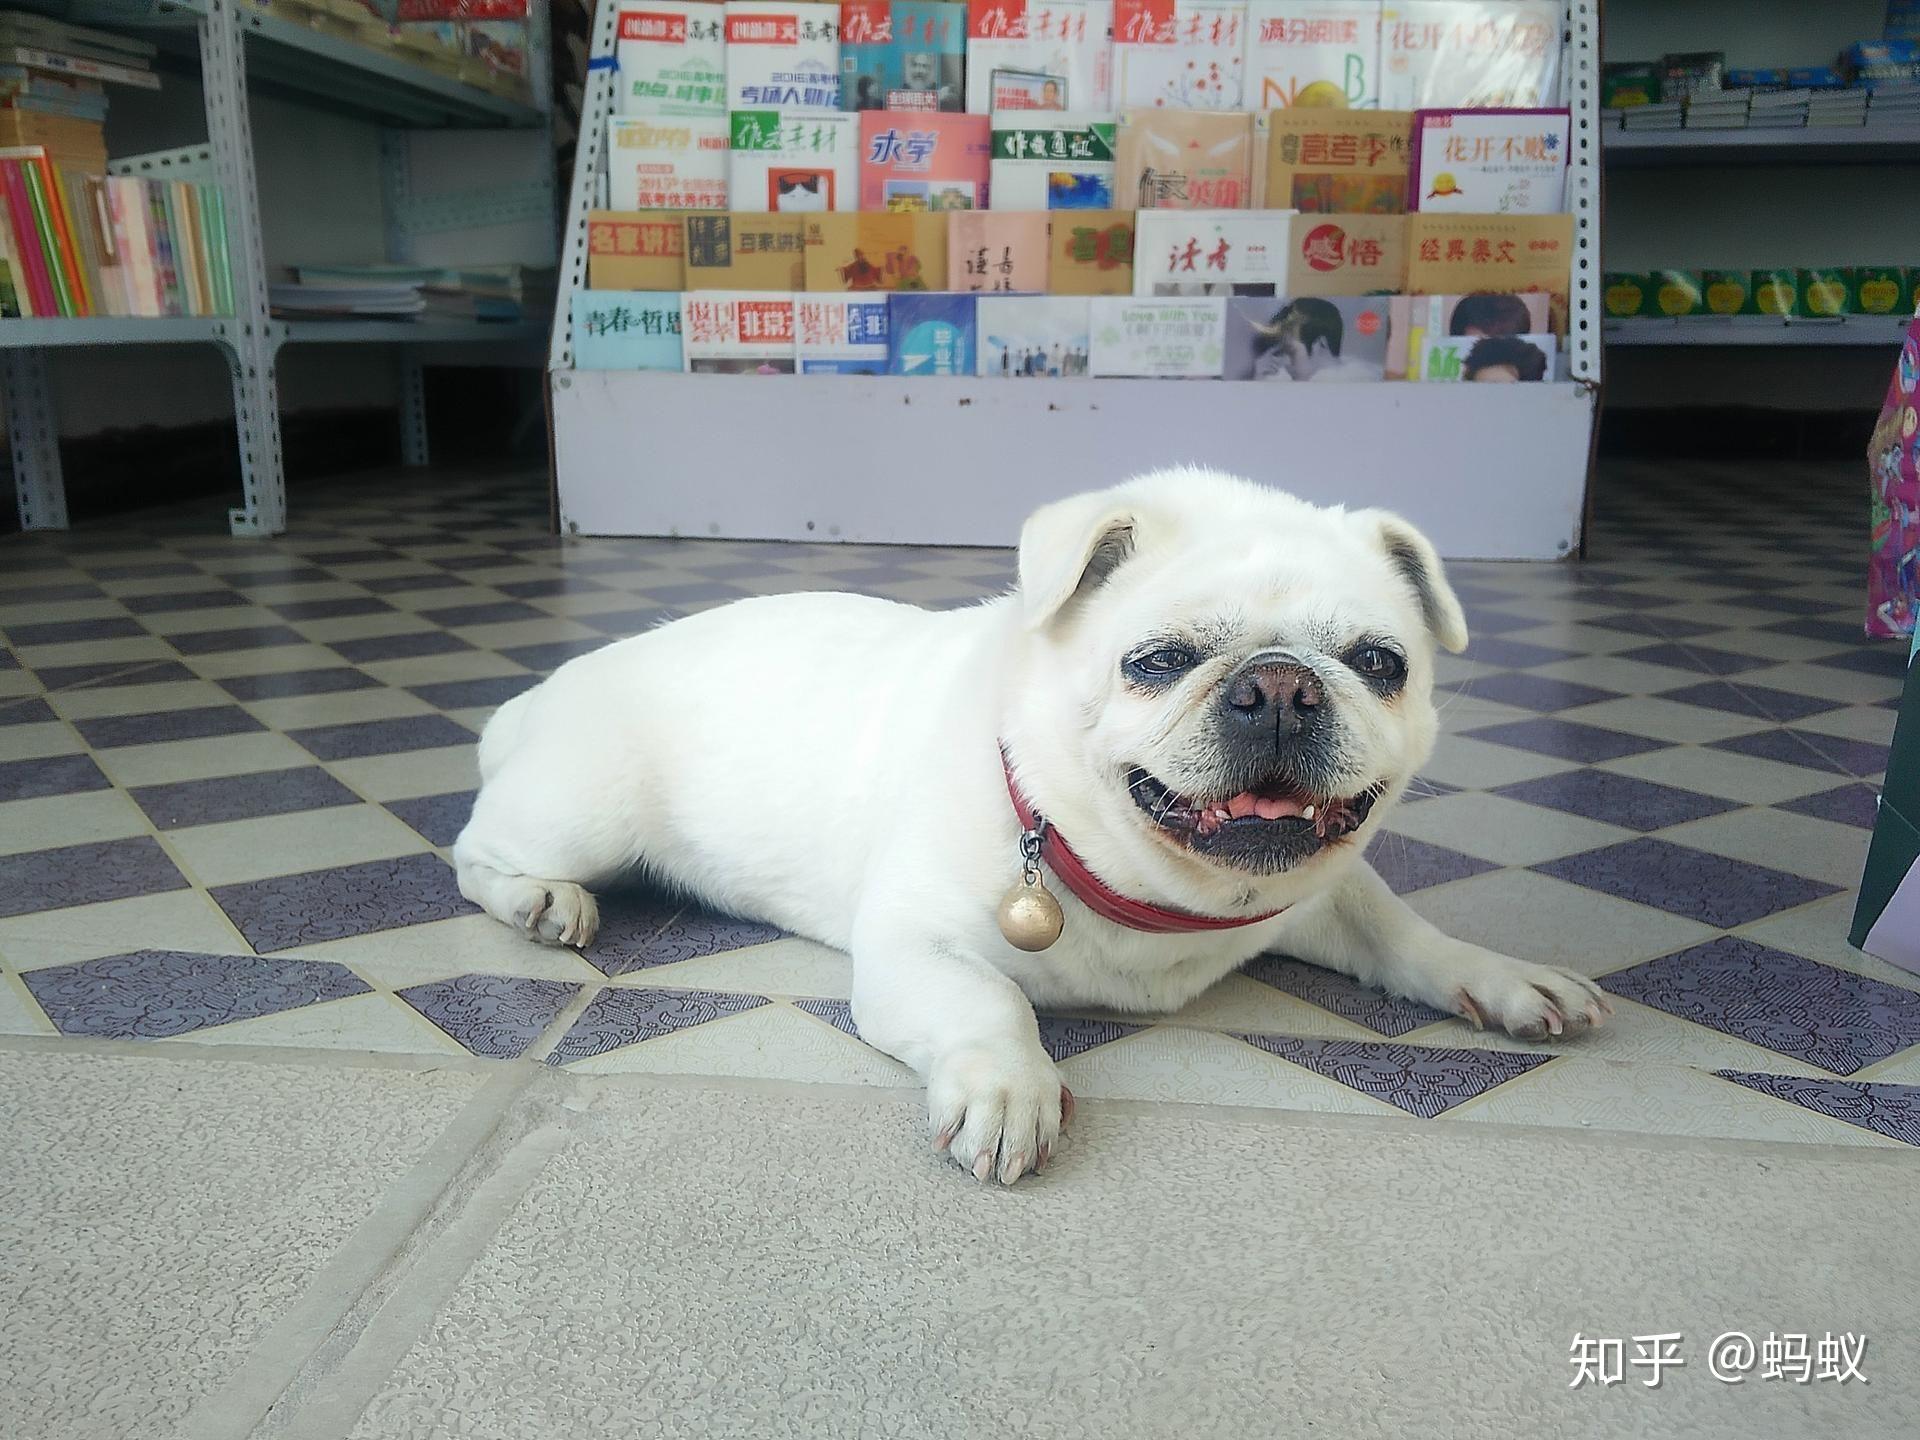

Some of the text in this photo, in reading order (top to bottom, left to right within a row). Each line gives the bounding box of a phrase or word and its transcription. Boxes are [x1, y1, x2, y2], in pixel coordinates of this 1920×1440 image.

[801, 20, 839, 41] 高考
[978, 8, 1087, 43] 作文素材
[1124, 9, 1239, 45] 作文素材
[737, 117, 837, 152] 作文素材
